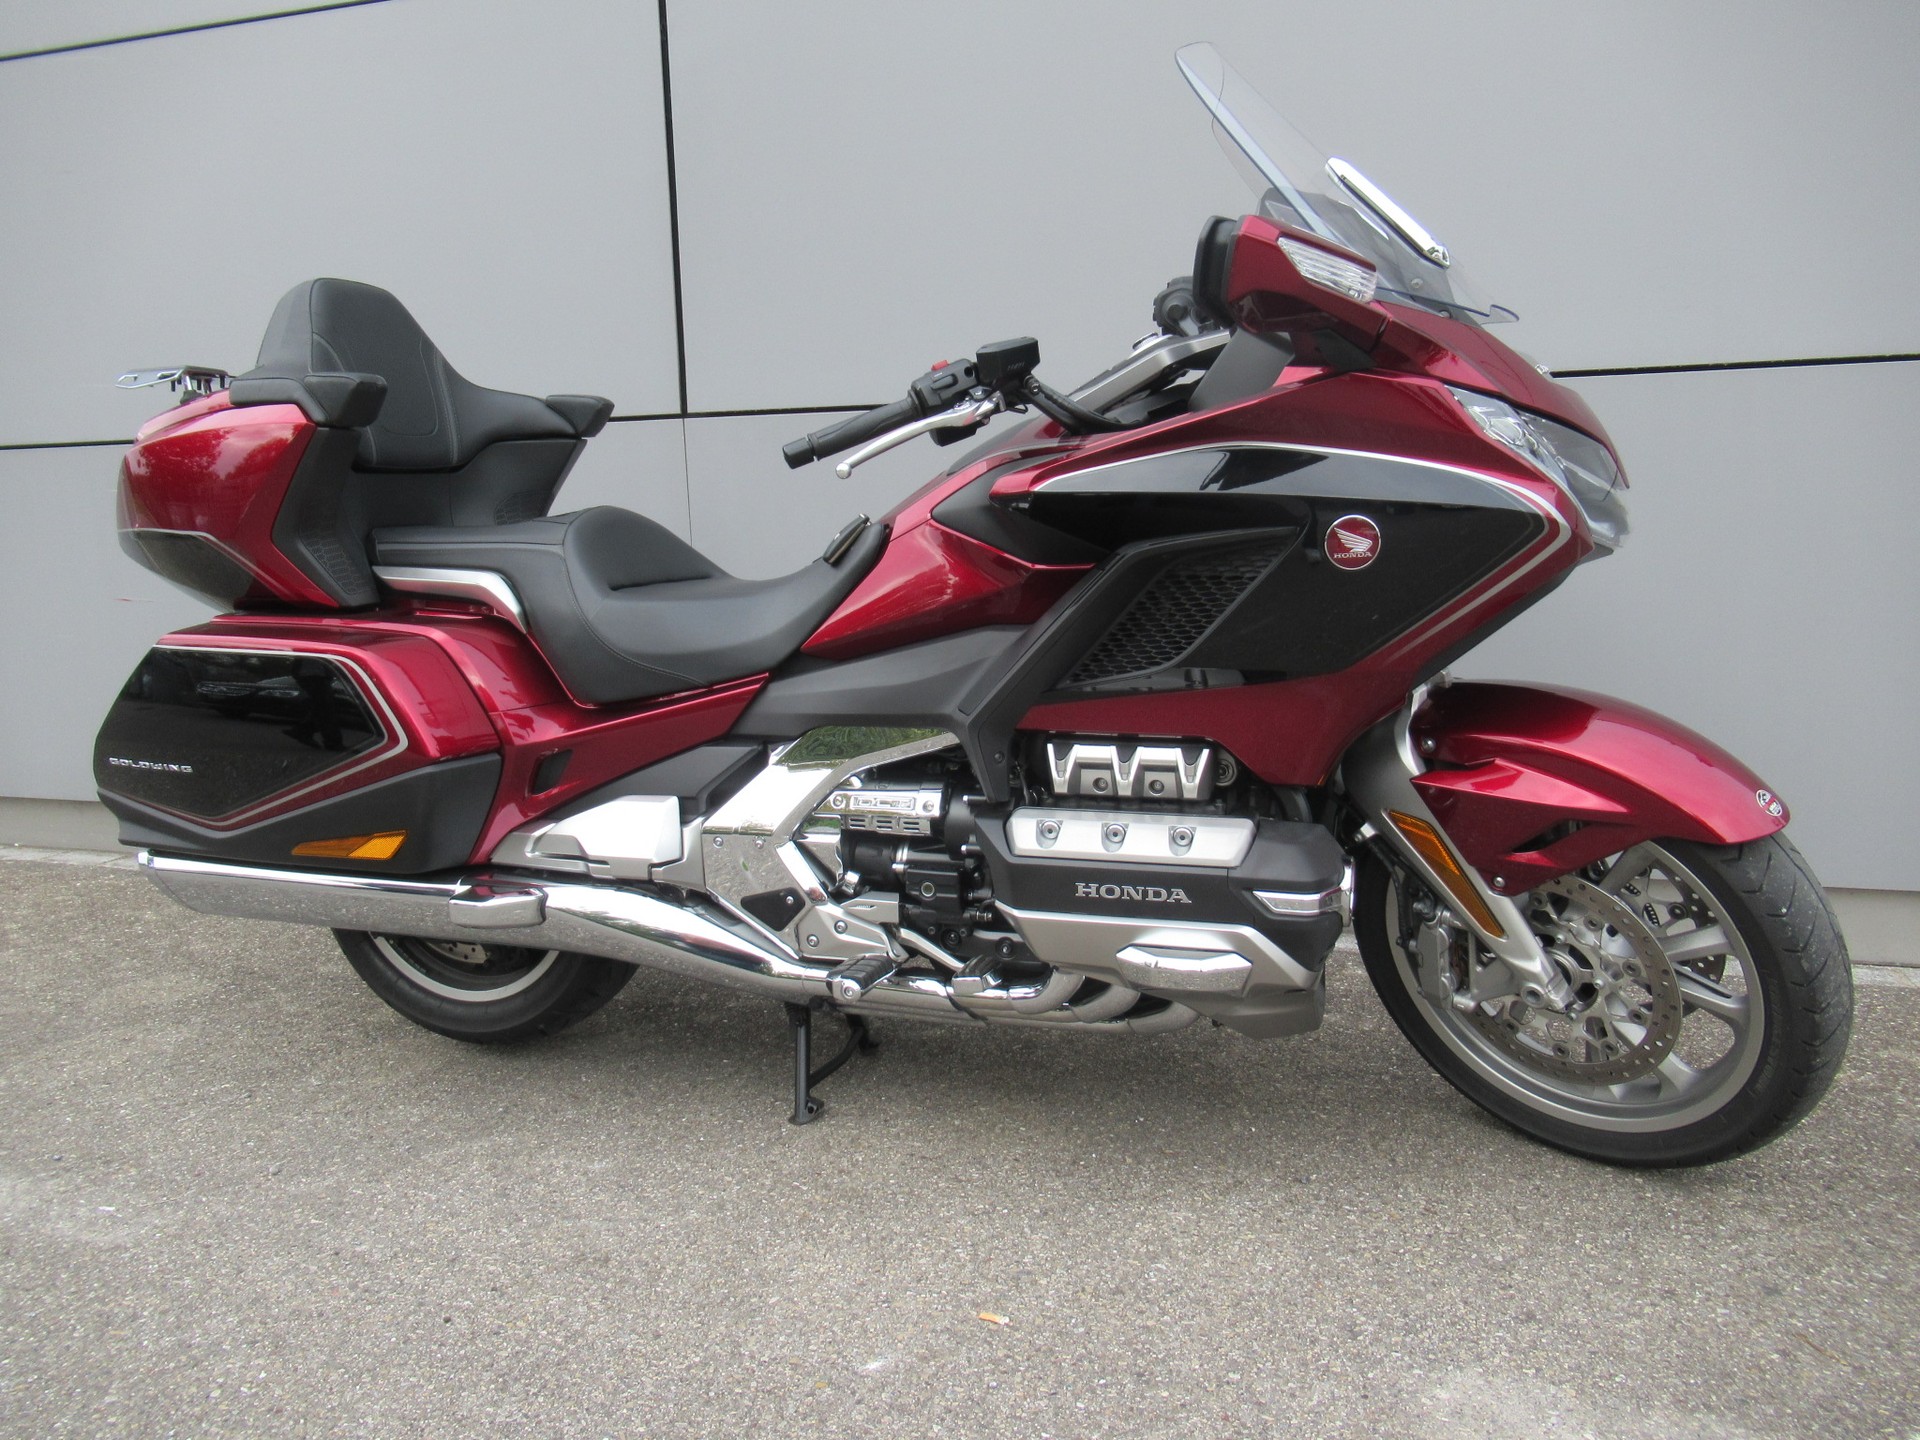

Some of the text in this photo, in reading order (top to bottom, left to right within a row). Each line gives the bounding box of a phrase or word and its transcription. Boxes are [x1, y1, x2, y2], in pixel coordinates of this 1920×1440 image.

[1333, 551, 1373, 559] HONDA
[109, 757, 193, 773] GOLDWING
[1075, 882, 1193, 904] HONDA
